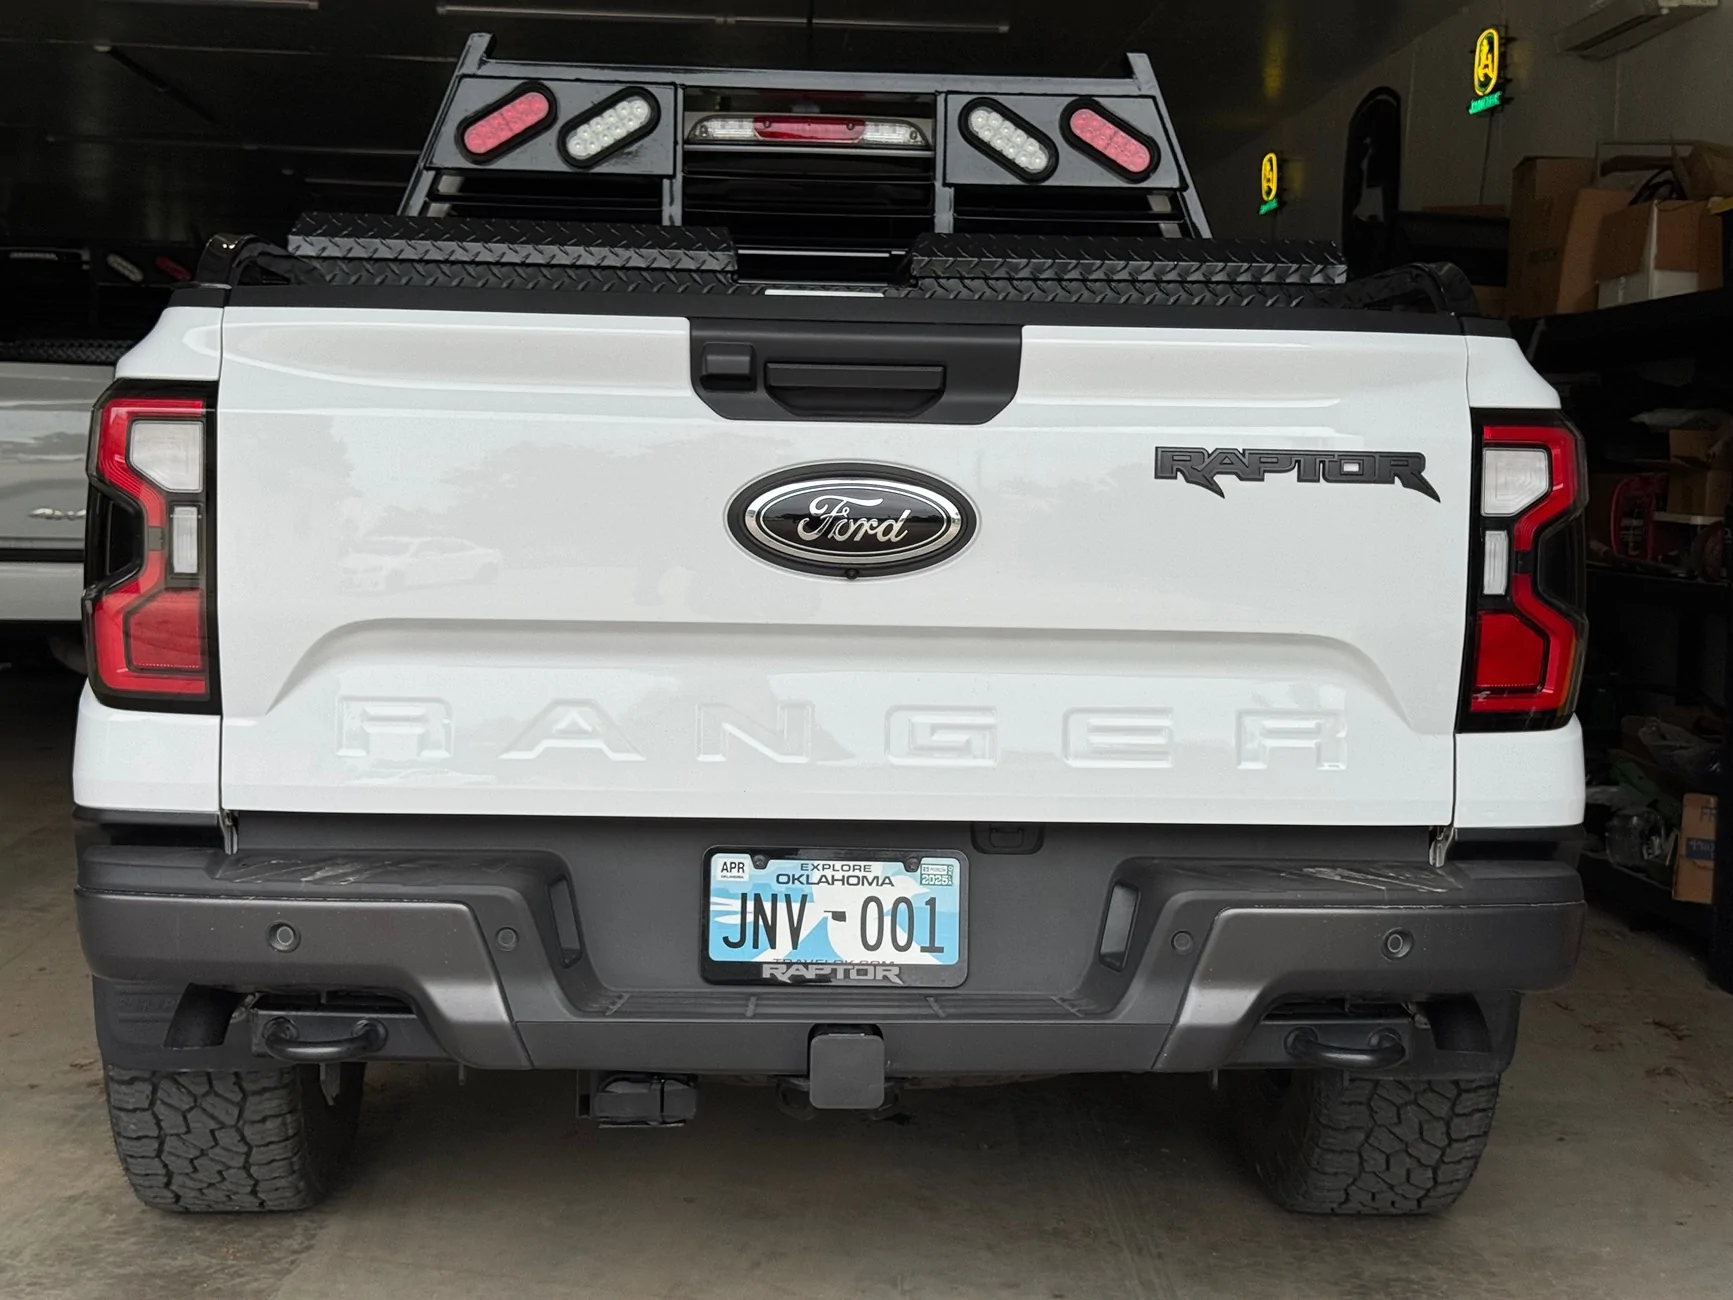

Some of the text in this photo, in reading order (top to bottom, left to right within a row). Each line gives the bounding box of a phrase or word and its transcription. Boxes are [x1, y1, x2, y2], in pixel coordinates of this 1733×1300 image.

[1154, 446, 1441, 503] RAPTOR
[797, 495, 911, 543] Ford
[334, 695, 1349, 771] RANGER
[721, 861, 745, 874] APR
[800, 863, 872, 873] EXPLORE
[776, 873, 894, 887] OKLAHOMA
[921, 874, 949, 885] 2025
[722, 892, 945, 954] JNV 001
[762, 963, 904, 985] RAPTOR
